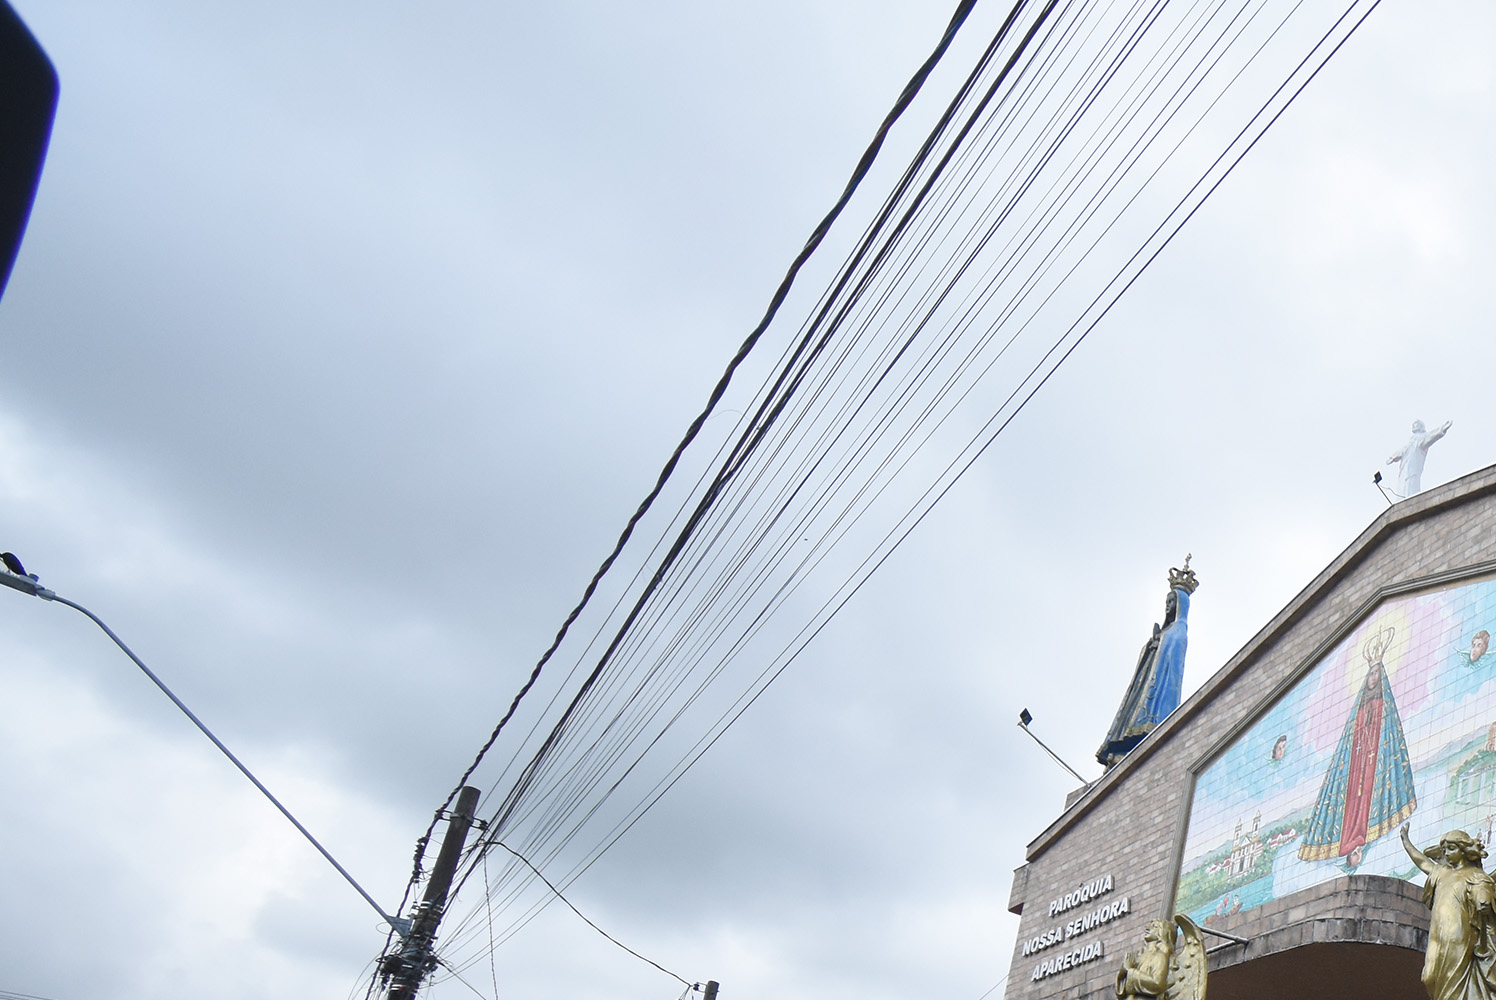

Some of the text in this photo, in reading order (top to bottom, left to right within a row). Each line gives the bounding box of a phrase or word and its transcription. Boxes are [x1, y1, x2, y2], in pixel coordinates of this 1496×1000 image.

[1022, 897, 1131, 957] NOSSA SENHORA
[1031, 940, 1104, 982] APARECIDA
